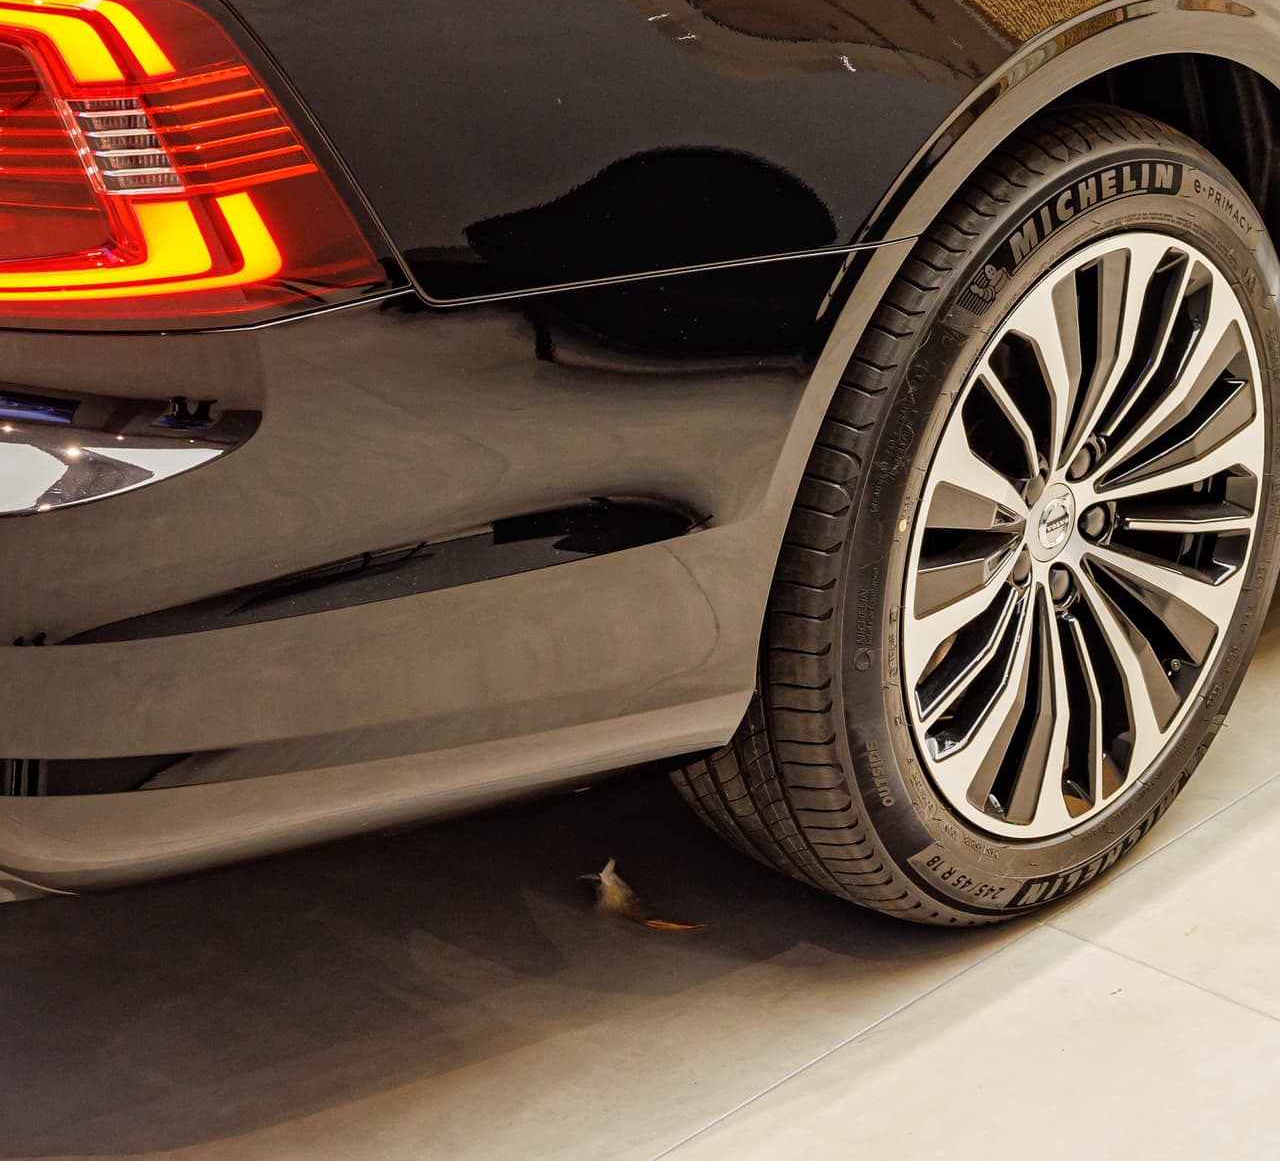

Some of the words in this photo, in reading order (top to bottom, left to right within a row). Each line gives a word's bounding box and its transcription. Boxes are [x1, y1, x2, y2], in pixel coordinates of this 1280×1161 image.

[1008, 163, 1174, 265] MICHELIN
[864, 741, 895, 807] OUTSIDE
[925, 854, 946, 873] 18
[940, 867, 954, 882] R
[951, 873, 1007, 901] 245/45
